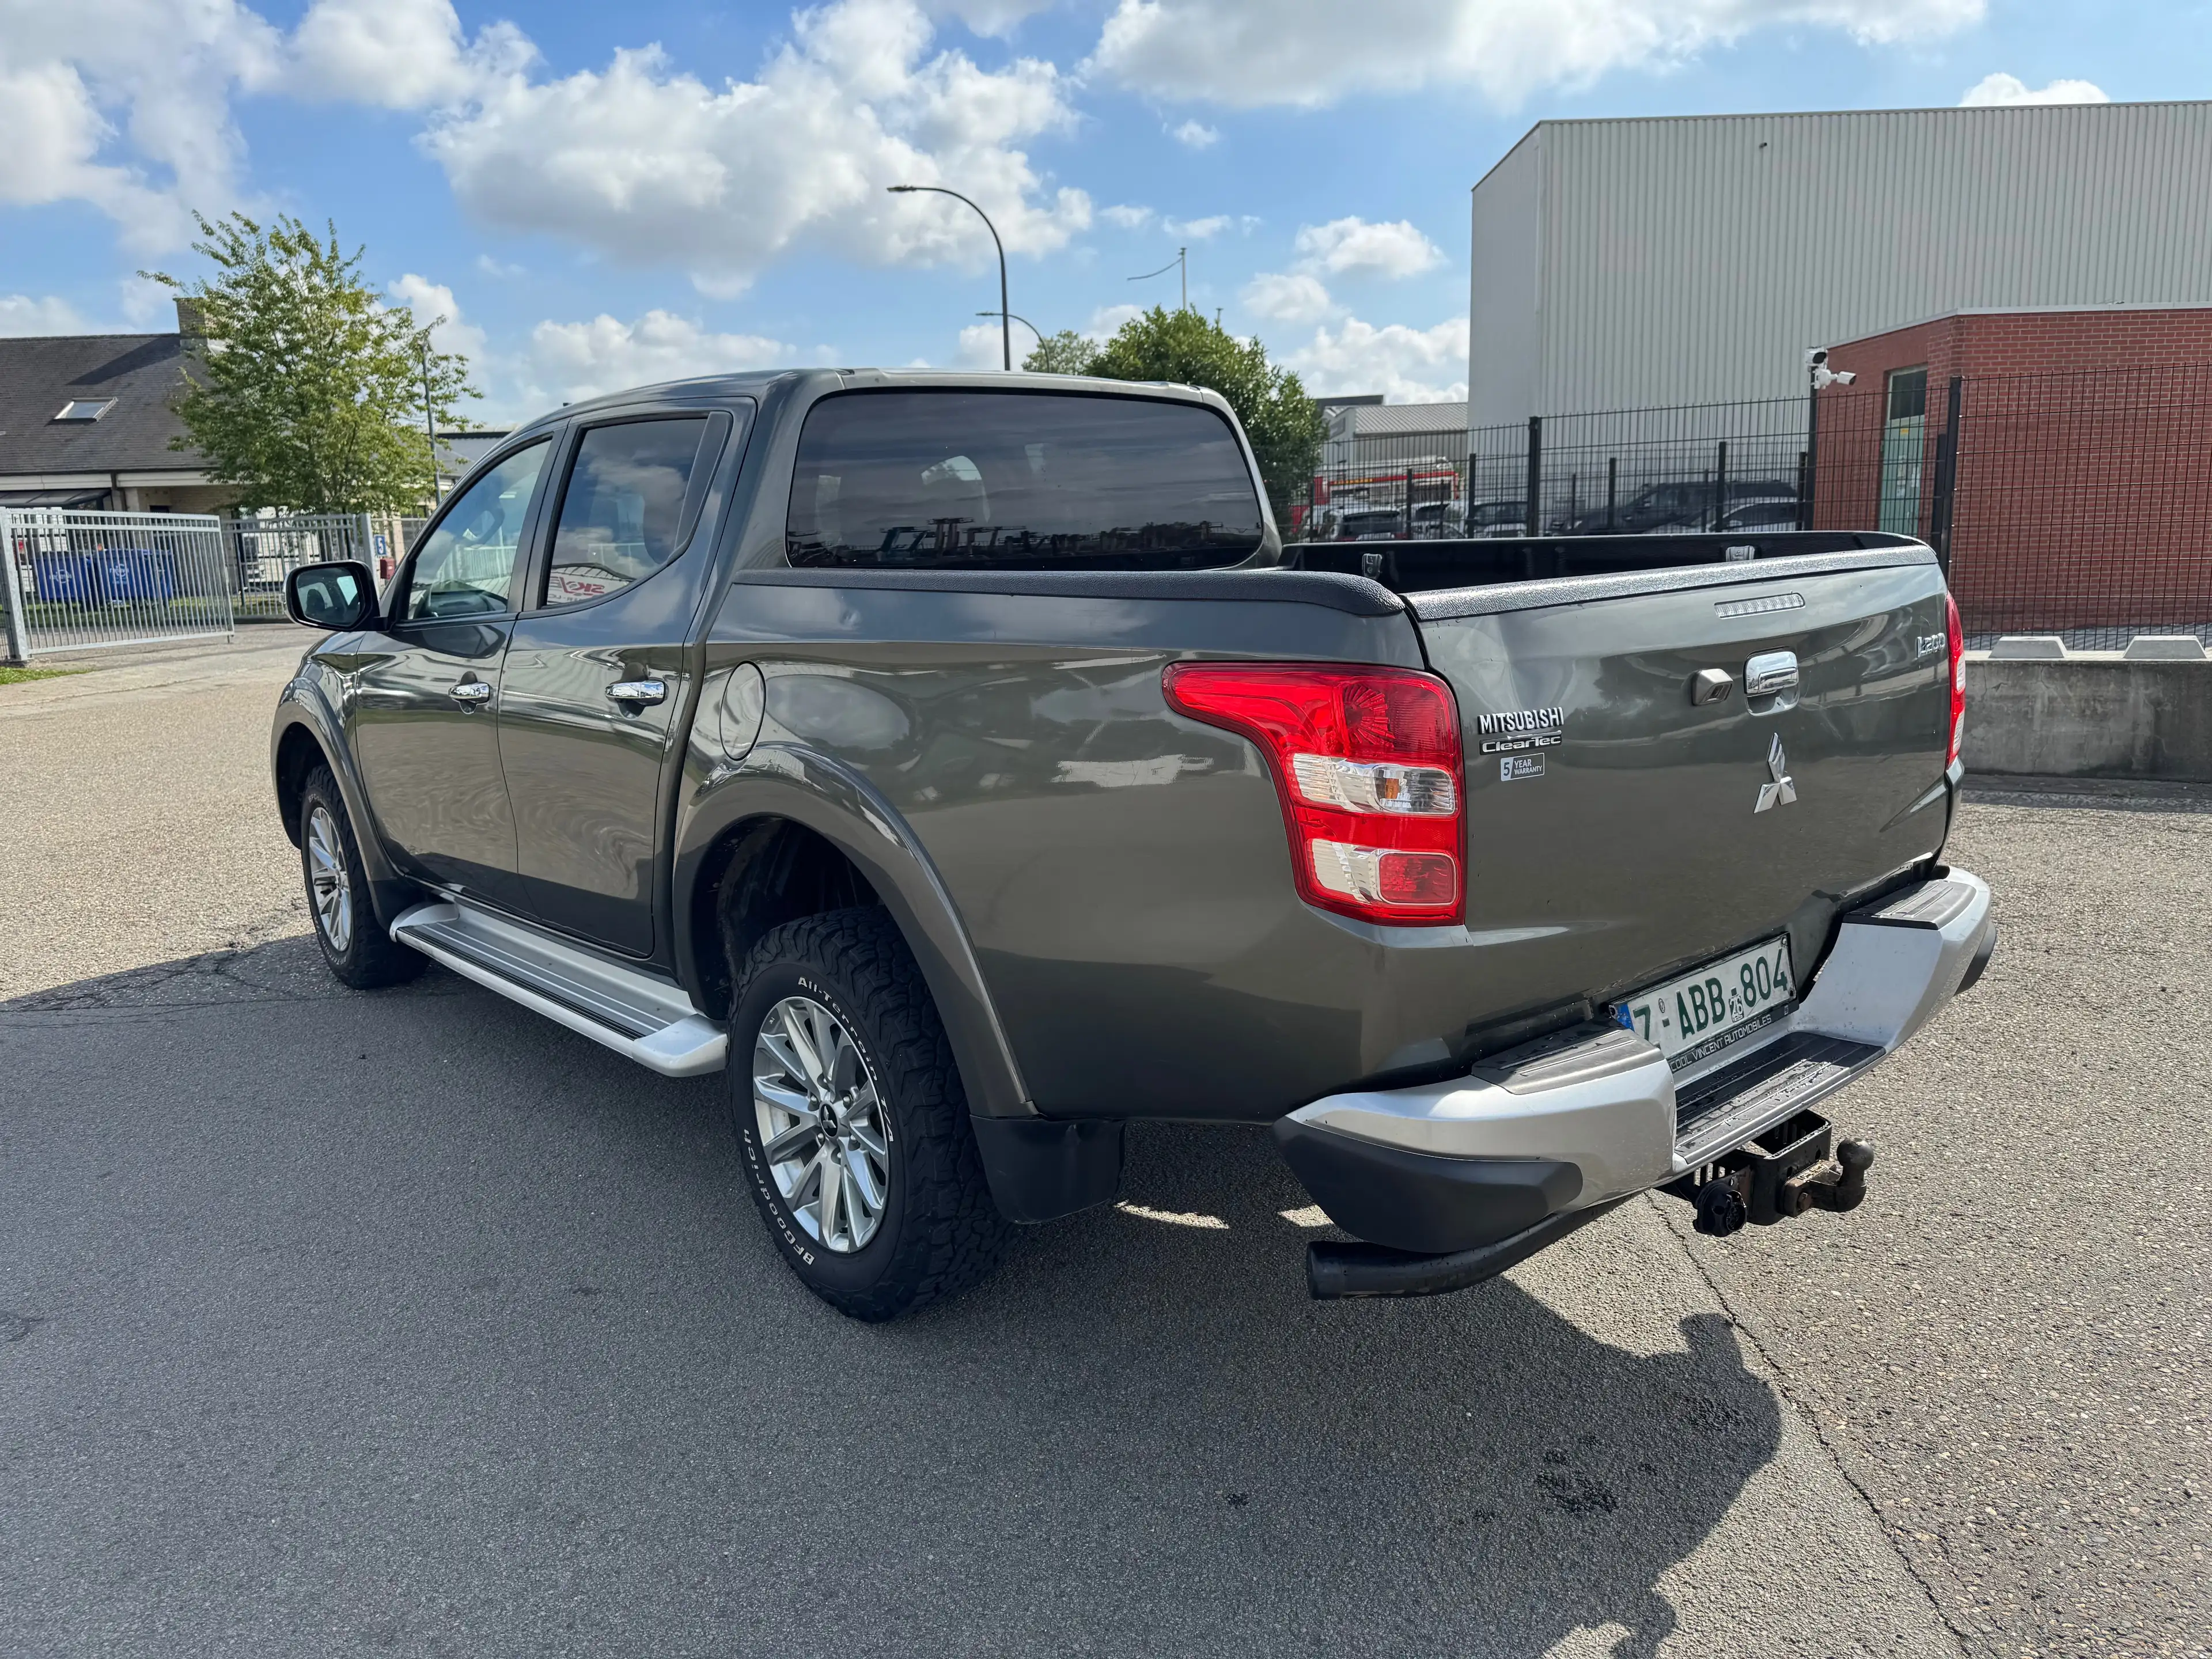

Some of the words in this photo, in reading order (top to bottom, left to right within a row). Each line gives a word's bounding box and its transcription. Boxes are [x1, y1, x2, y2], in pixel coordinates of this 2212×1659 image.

[377, 537, 384, 554] 5
[1478, 707, 1564, 734] MITSUBISHI
[1482, 736, 1562, 753] ClearTec
[1503, 762, 1510, 777] 5
[1514, 758, 1532, 767] YEAR
[1514, 765, 1543, 775] WARRANTY
[798, 976, 878, 1081] All-Terrain
[1692, 1039, 1724, 1060] VINCENT
[1725, 1014, 1772, 1046] AUTOMOBILES
[743, 1128, 816, 1266] BFGoodrich
